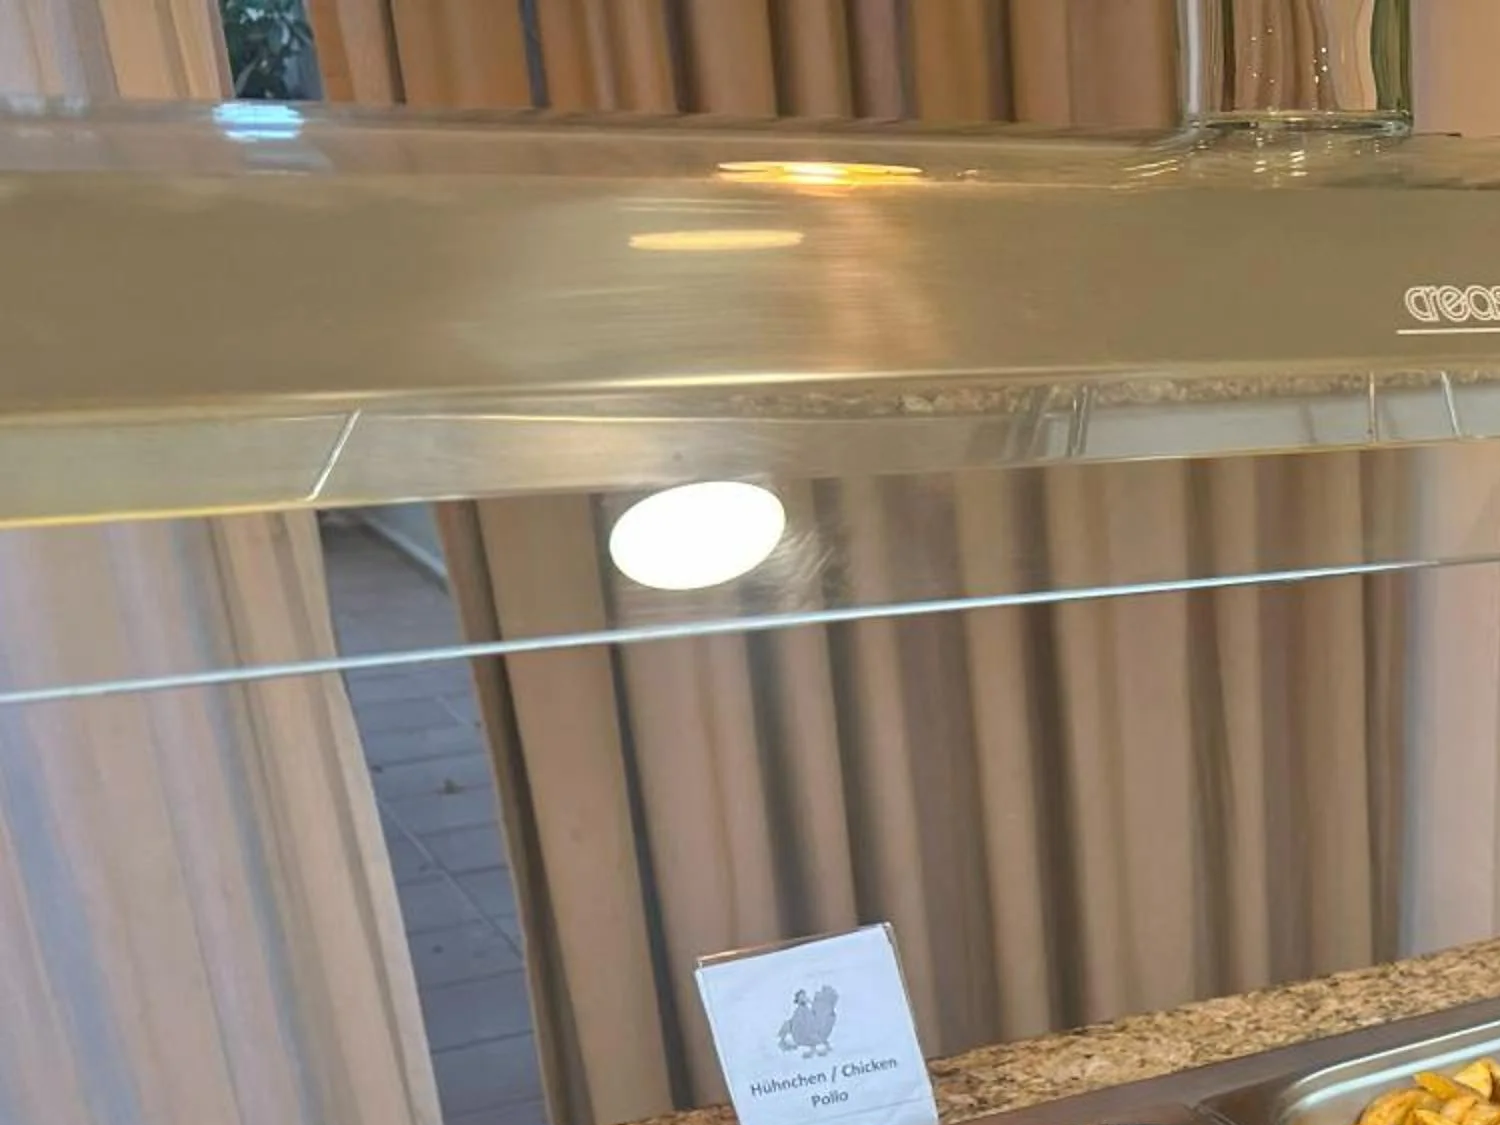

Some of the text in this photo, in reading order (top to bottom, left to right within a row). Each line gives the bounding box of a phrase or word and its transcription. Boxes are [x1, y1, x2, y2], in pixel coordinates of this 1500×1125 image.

[751, 1072, 827, 1097] Hühnchen
[841, 1058, 898, 1077] Chicken
[811, 1090, 849, 1108] Pollo
